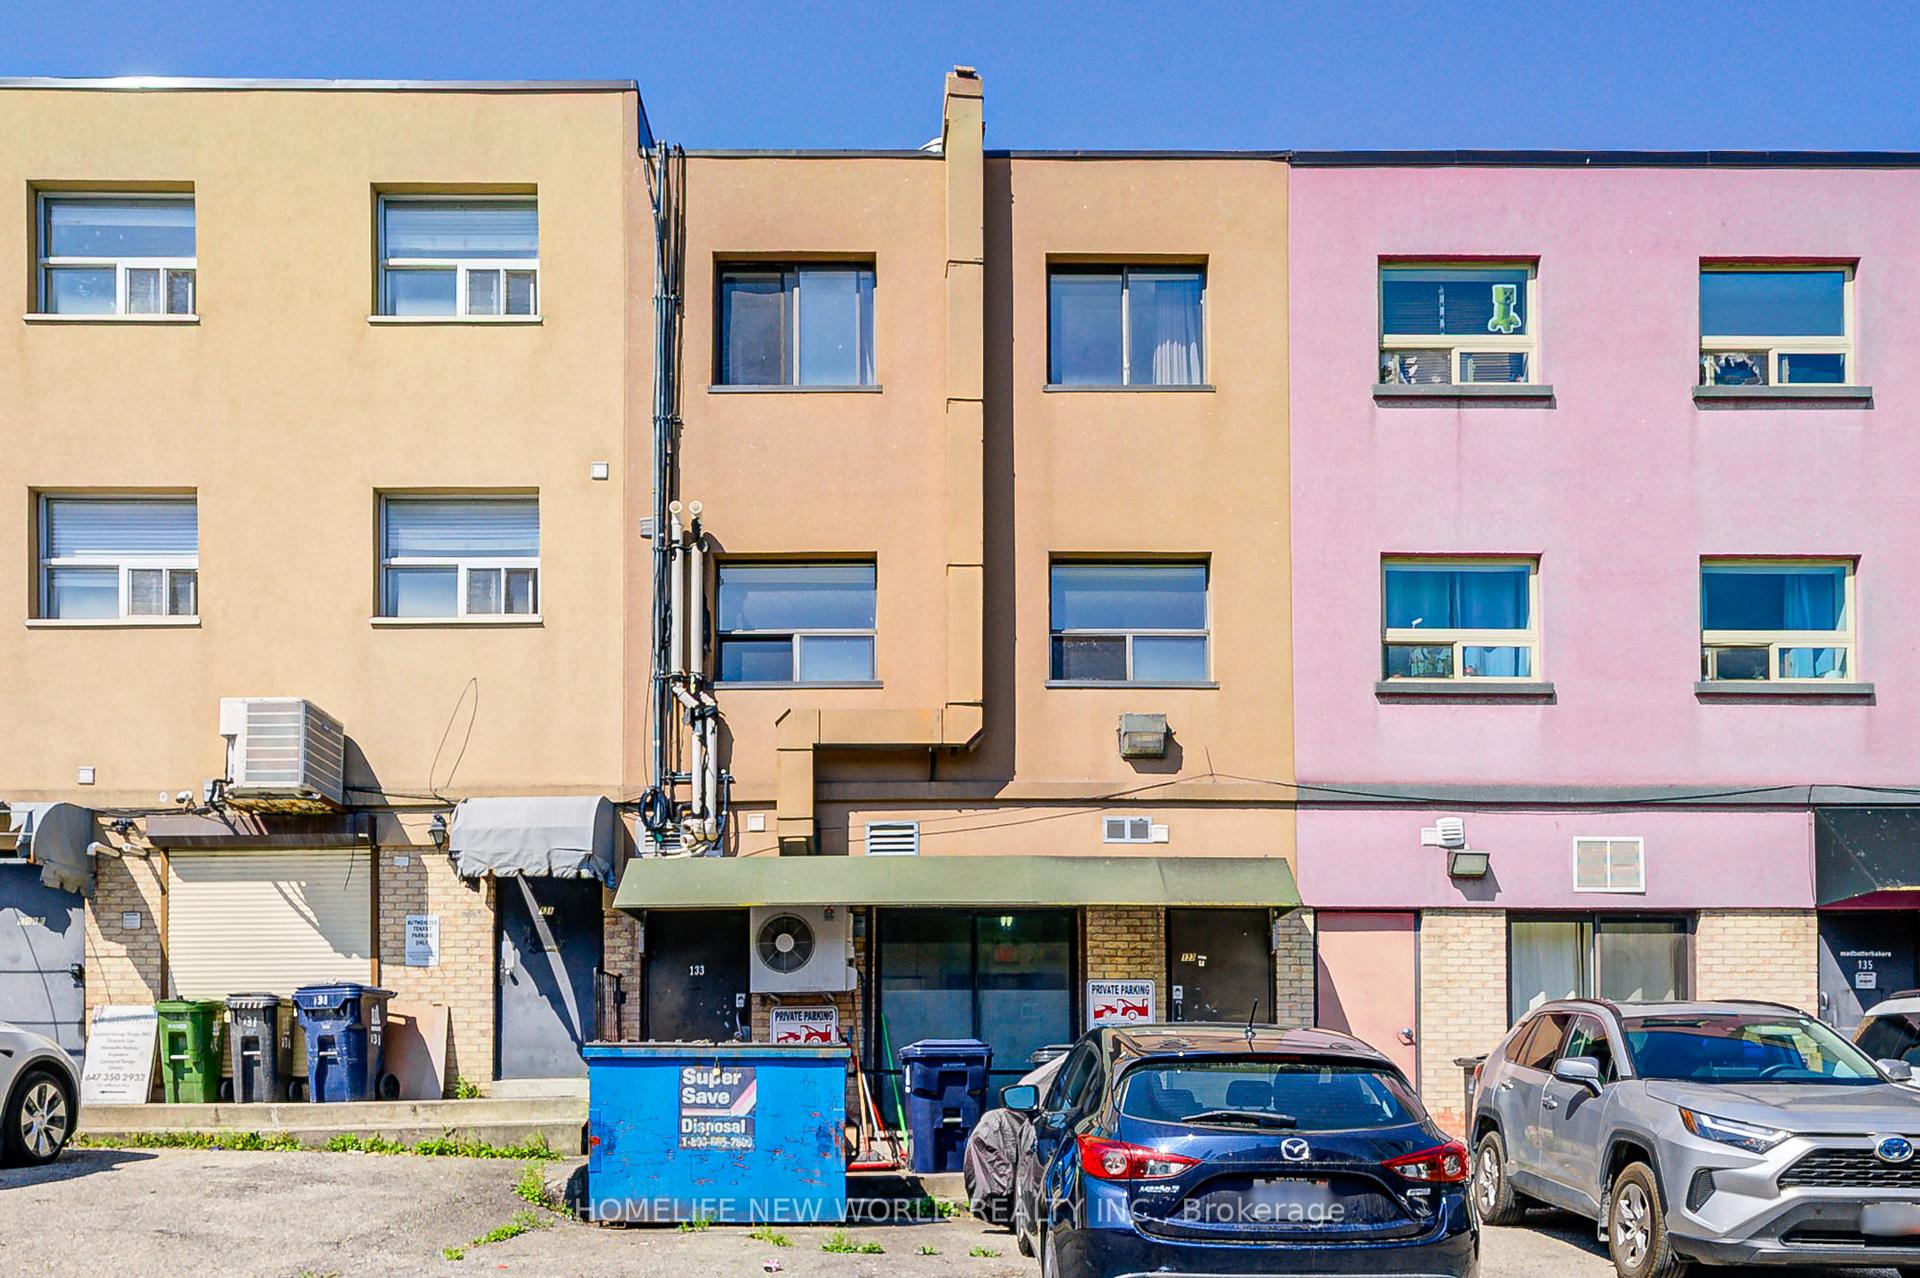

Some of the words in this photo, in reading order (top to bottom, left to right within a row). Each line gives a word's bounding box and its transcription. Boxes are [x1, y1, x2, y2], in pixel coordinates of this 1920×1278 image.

[689, 965, 705, 976] 133
[1858, 960, 1873, 970] 135
[1091, 984, 1120, 995] PRIVATE
[1121, 984, 1150, 995] PARKING
[775, 1010, 803, 1022] PRIVATE
[804, 1010, 834, 1022] PARKING
[85, 1073, 101, 1081] 647
[103, 1073, 121, 1081] 350
[122, 1073, 146, 1082] 2932
[682, 1068, 742, 1089] Super
[682, 1087, 730, 1105] Save
[681, 1118, 746, 1136] Disposal
